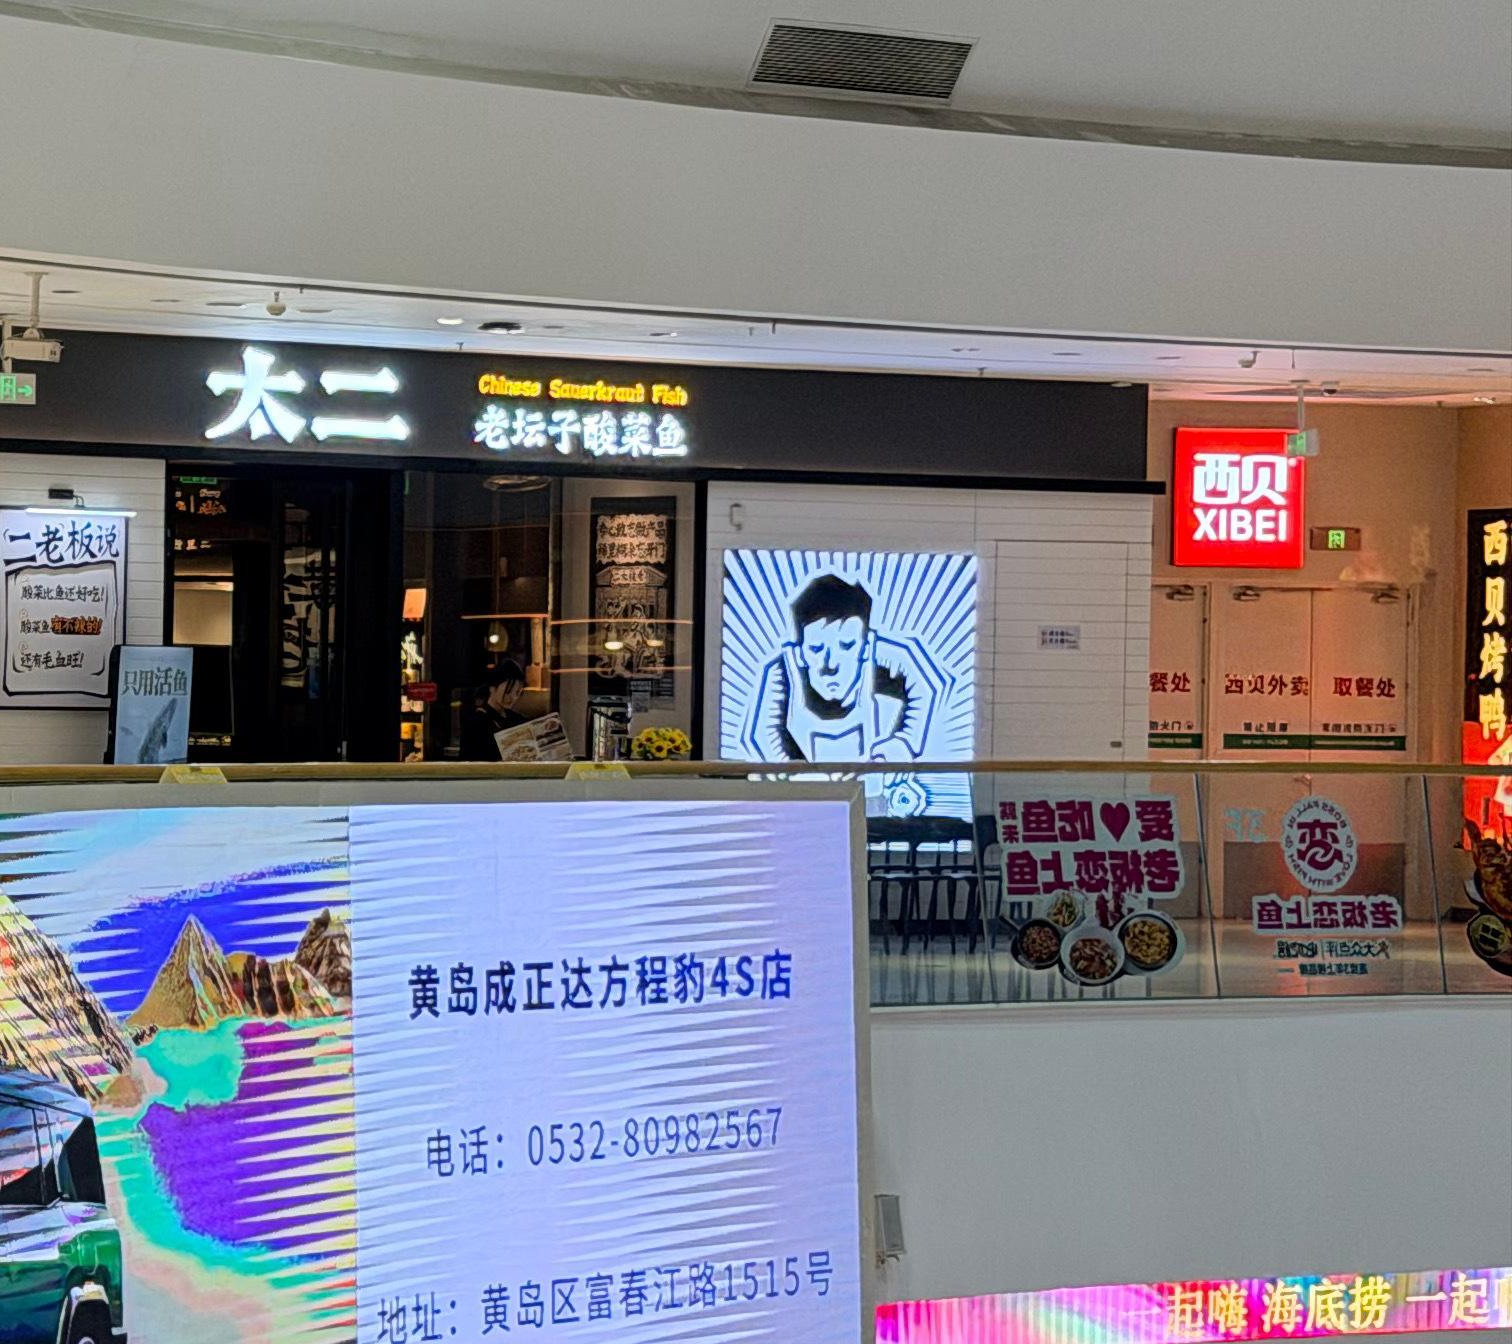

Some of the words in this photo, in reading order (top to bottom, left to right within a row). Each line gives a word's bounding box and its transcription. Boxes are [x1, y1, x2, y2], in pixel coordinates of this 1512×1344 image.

[204, 345, 410, 444] 太二
[478, 373, 542, 398] Chinese
[549, 378, 646, 405] Sauerkraut
[651, 382, 688, 407] Fish
[474, 404, 688, 458] 老坛子酸菜鱼
[1192, 452, 1288, 506] 西贝
[1192, 507, 1288, 543] XIBEI
[1479, 519, 1509, 742] 西贝烤鸭
[120, 666, 188, 697] 只用活鱼
[1224, 673, 1310, 696] 西贝外卖
[1332, 675, 1396, 698] 取餐处
[407, 948, 793, 1021] 黄岛成正达方程豹4S店
[1261, 1274, 1392, 1332] 海底捞
